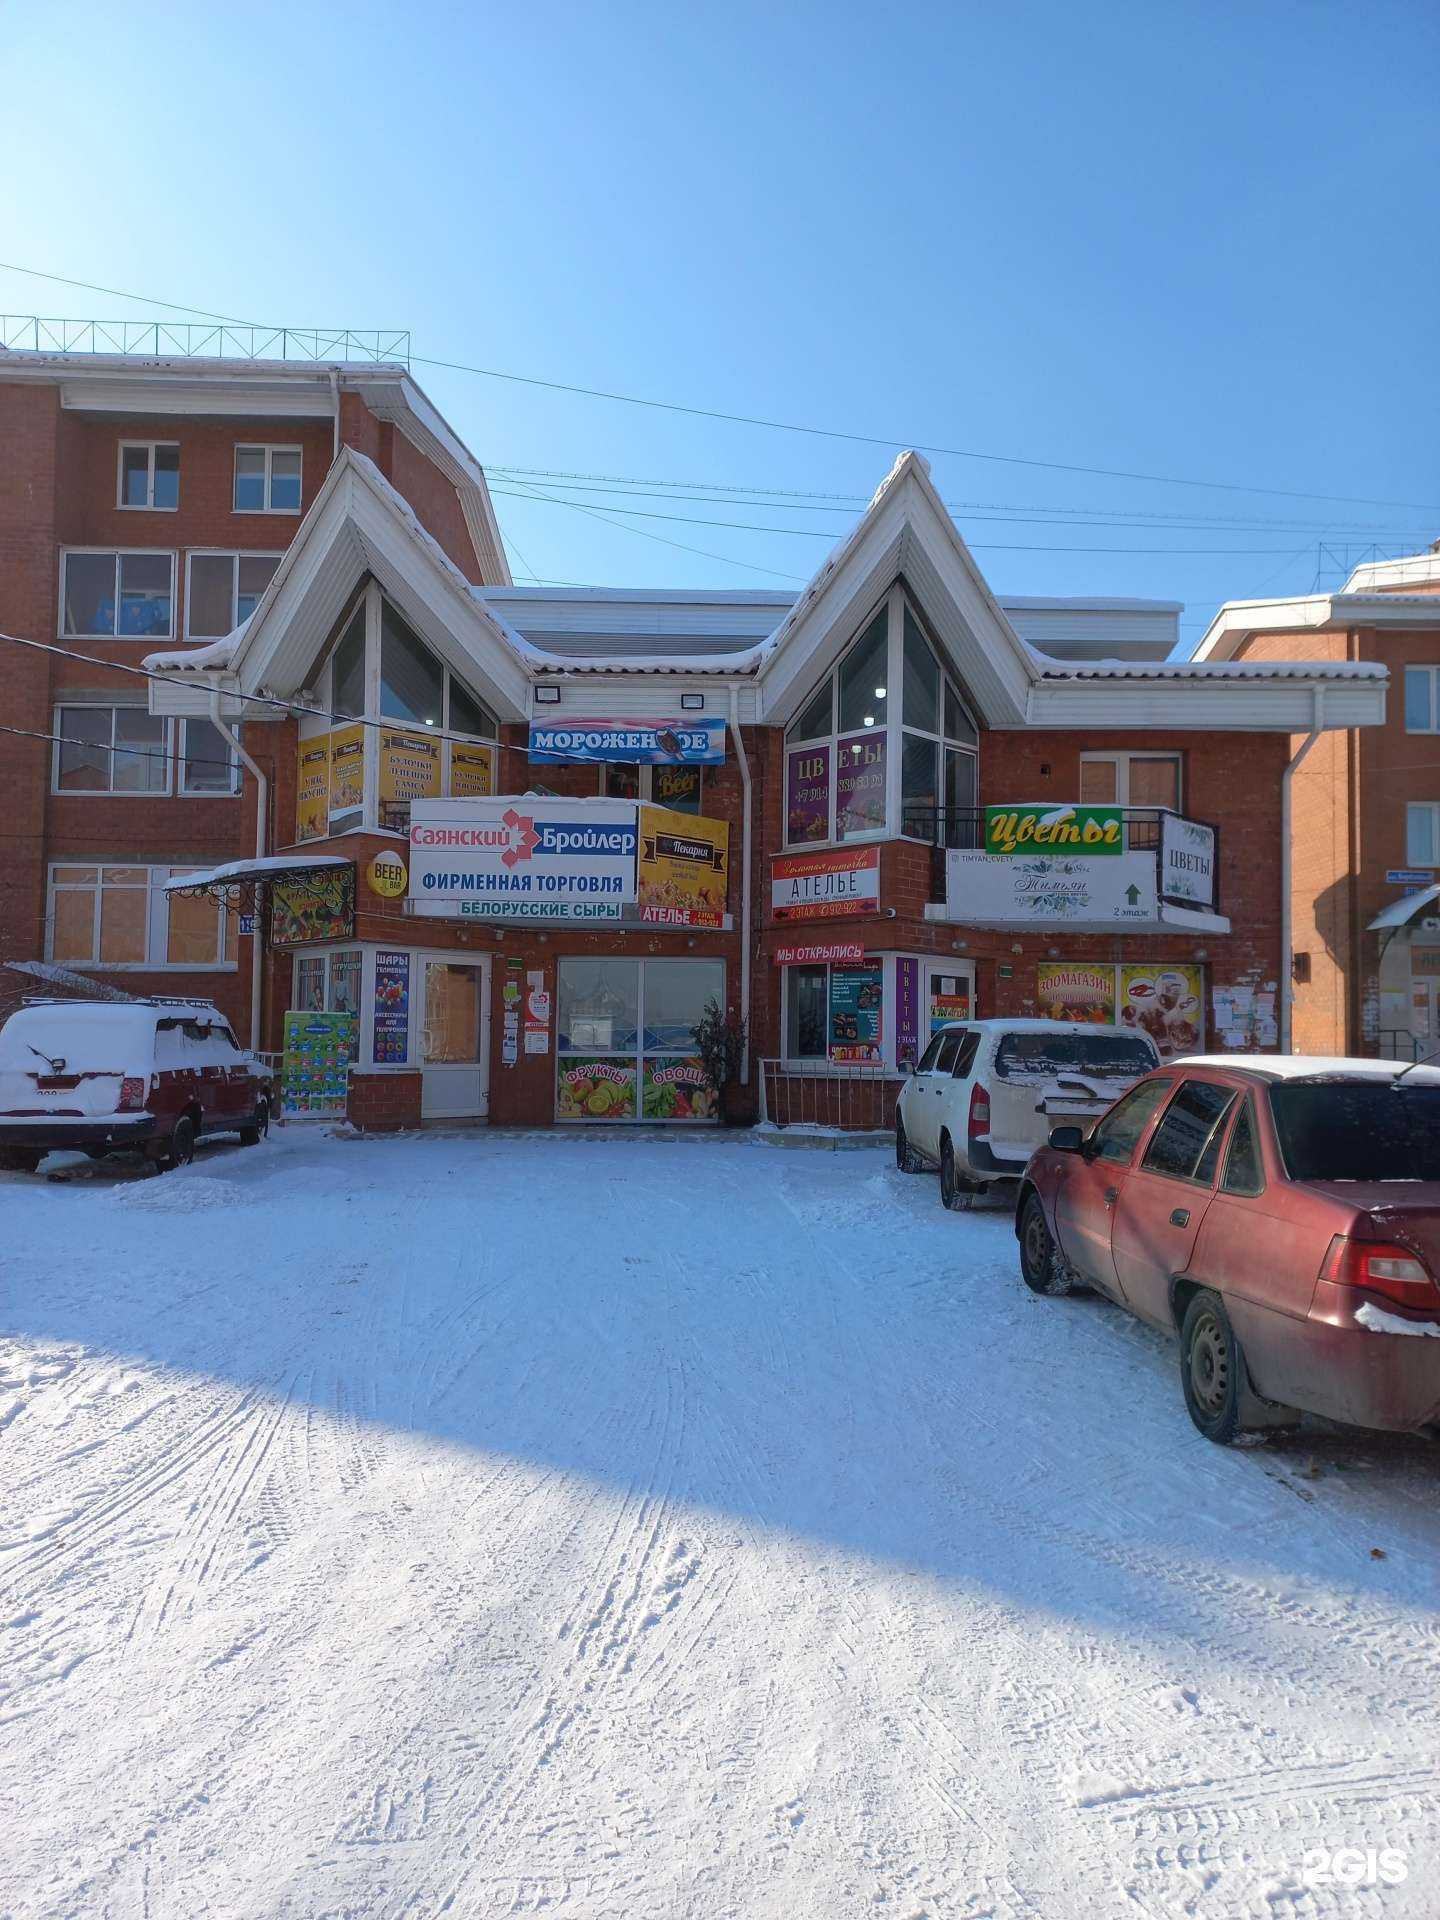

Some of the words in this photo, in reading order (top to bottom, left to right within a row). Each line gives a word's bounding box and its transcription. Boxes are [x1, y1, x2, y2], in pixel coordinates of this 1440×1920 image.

[660, 773, 698, 796] Beer
[410, 825, 510, 846] Саянский
[543, 828, 635, 854] Бройлер
[990, 809, 1121, 852] Цветы
[674, 840, 709, 858] Пекарня
[375, 863, 402, 880] BEER
[1170, 849, 1210, 876] ЦВЕТЫ
[422, 873, 531, 891] ФИРМЕННАЯ
[536, 876, 623, 893] ТОРГОВЛЯ
[791, 871, 857, 898] АТЕЛЬЕ
[461, 901, 568, 917] БЕЛОРУССКИЕ
[574, 903, 620, 918] СЫРЫ
[642, 907, 691, 924] АТЕЛЬЕ
[1113, 907, 1120, 917] 2
[1121, 909, 1150, 917] этаж
[376, 954, 408, 966] ШАРЫ
[777, 949, 795, 961] МЫ
[797, 945, 862, 960] ОТКРЫЛИСЬ
[1039, 972, 1112, 995] ЗООМАГАЗИН
[566, 1064, 628, 1086] ФРУКТЫ
[652, 1066, 712, 1086] ОВОЩИ
